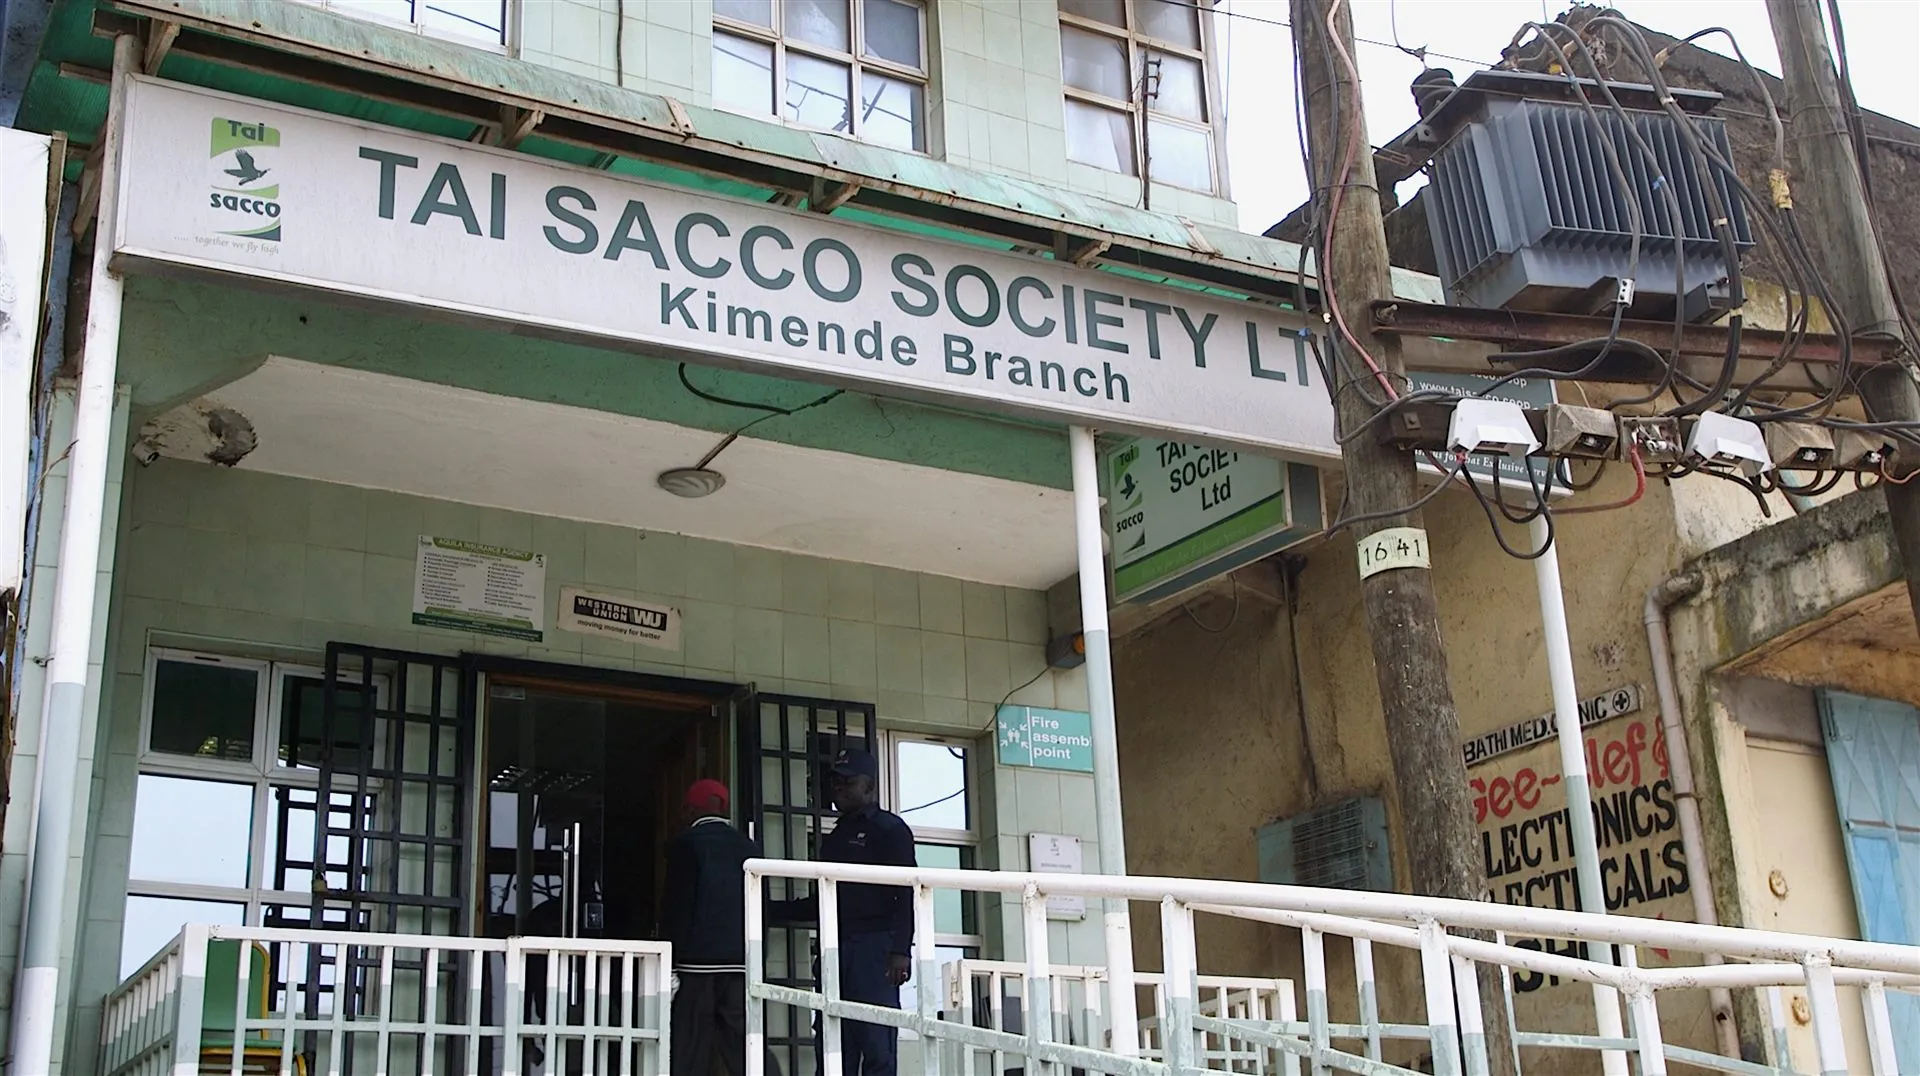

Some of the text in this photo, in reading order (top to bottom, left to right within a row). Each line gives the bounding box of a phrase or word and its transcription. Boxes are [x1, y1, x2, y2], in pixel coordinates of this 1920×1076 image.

[228, 119, 265, 142] Tai
[210, 192, 281, 218] sacco
[358, 146, 1334, 388] TAI SACCO SOCIETY LT
[660, 282, 1131, 403] Kimende Branch
[1118, 444, 1135, 466] Tai
[1483, 456, 1525, 474] Exlusive
[1201, 474, 1231, 511] Ltd
[1116, 511, 1144, 533] sacco
[577, 597, 662, 628] WESTERN WU
[592, 606, 628, 622] UNION
[577, 619, 662, 641] moving money for better
[1031, 715, 1060, 730] Fire
[1032, 731, 1093, 748] assemb
[1033, 746, 1072, 760] point
